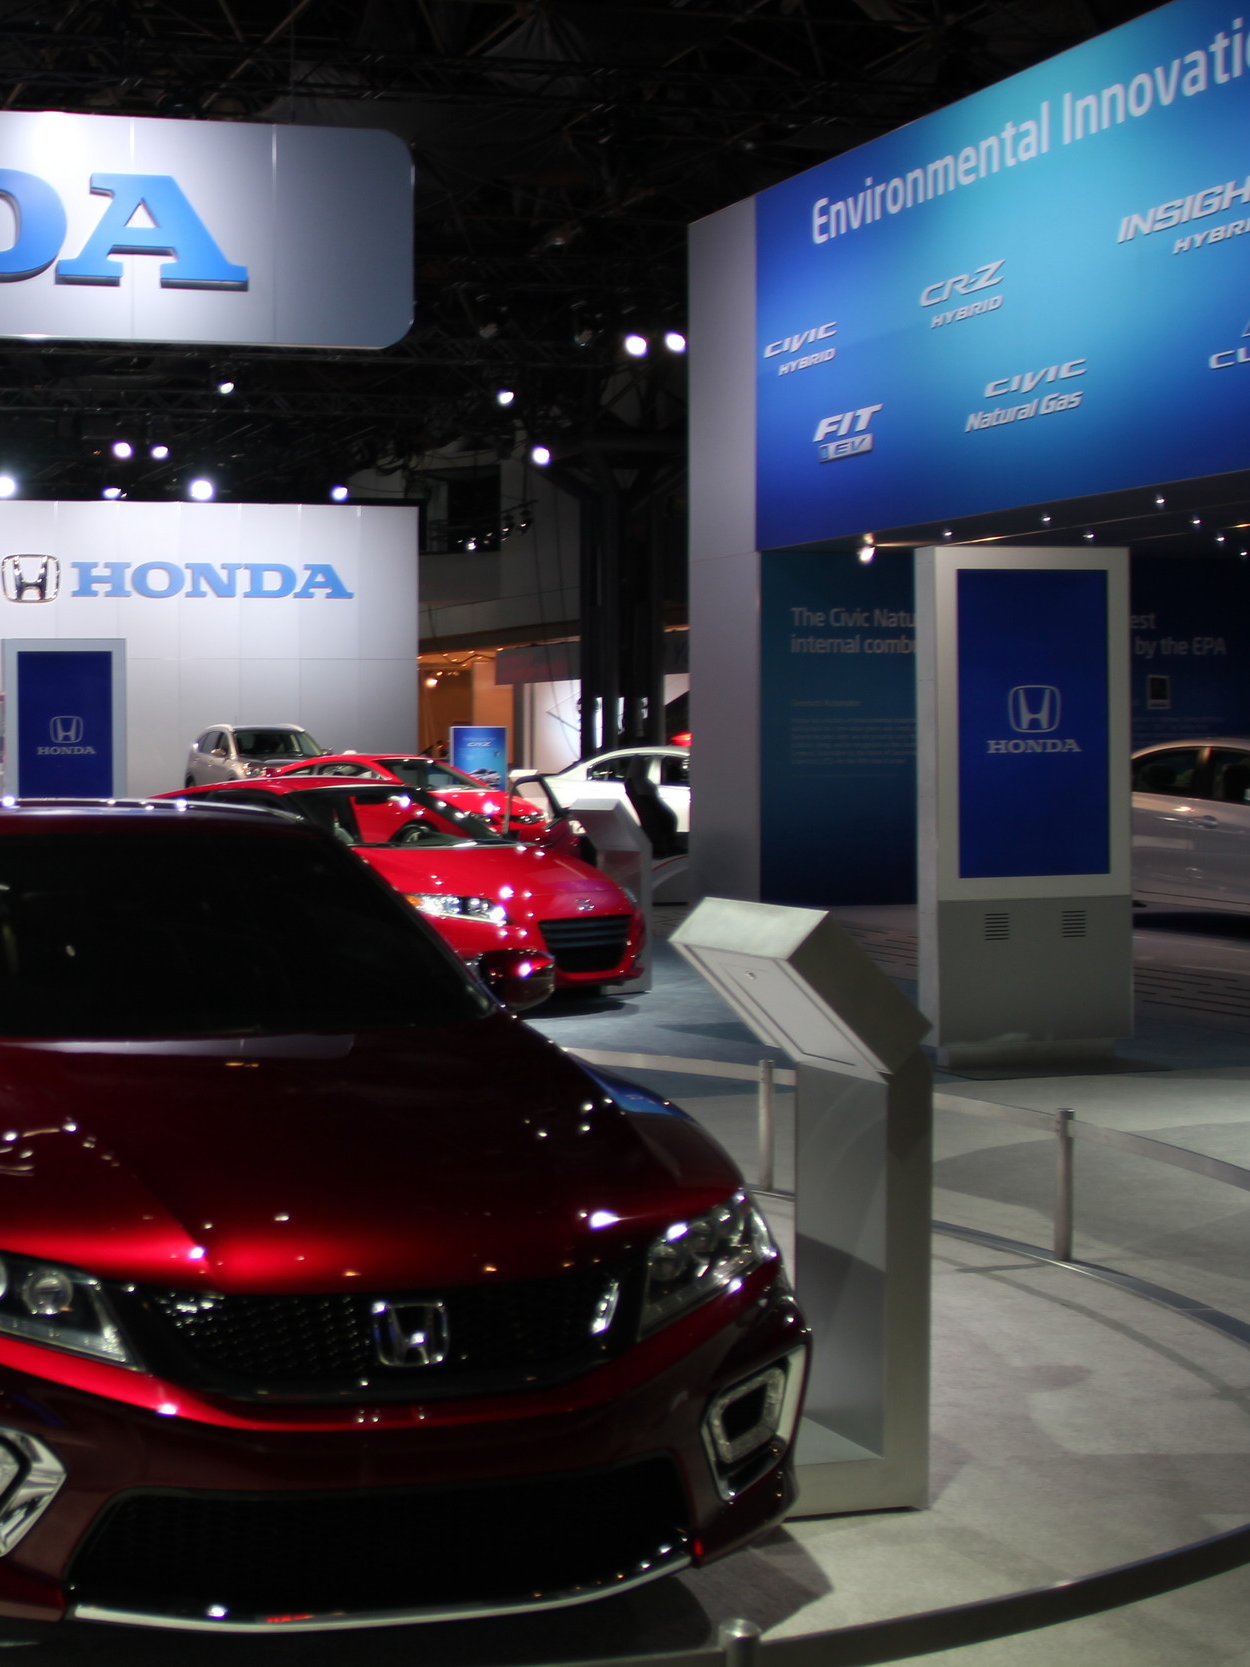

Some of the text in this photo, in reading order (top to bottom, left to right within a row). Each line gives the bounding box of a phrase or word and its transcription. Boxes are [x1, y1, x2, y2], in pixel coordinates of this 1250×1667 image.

[812, 16, 1250, 245] Environmental Innovati
[920, 258, 1007, 307] CR-Z
[930, 294, 1004, 329] HYBRID
[763, 321, 838, 359] CIVIC
[778, 347, 837, 377] HYBRID
[984, 358, 1087, 398] CIVIC
[813, 403, 884, 442] FIT
[964, 390, 1084, 433] Natural Gas
[71, 561, 355, 599] HONDA
[790, 607, 826, 627] The
[830, 607, 870, 627] Civic
[790, 634, 861, 654] internal
[1135, 636, 1227, 658] by the EPA
[36, 745, 97, 756] HONDA
[986, 739, 1083, 754] HONDA
